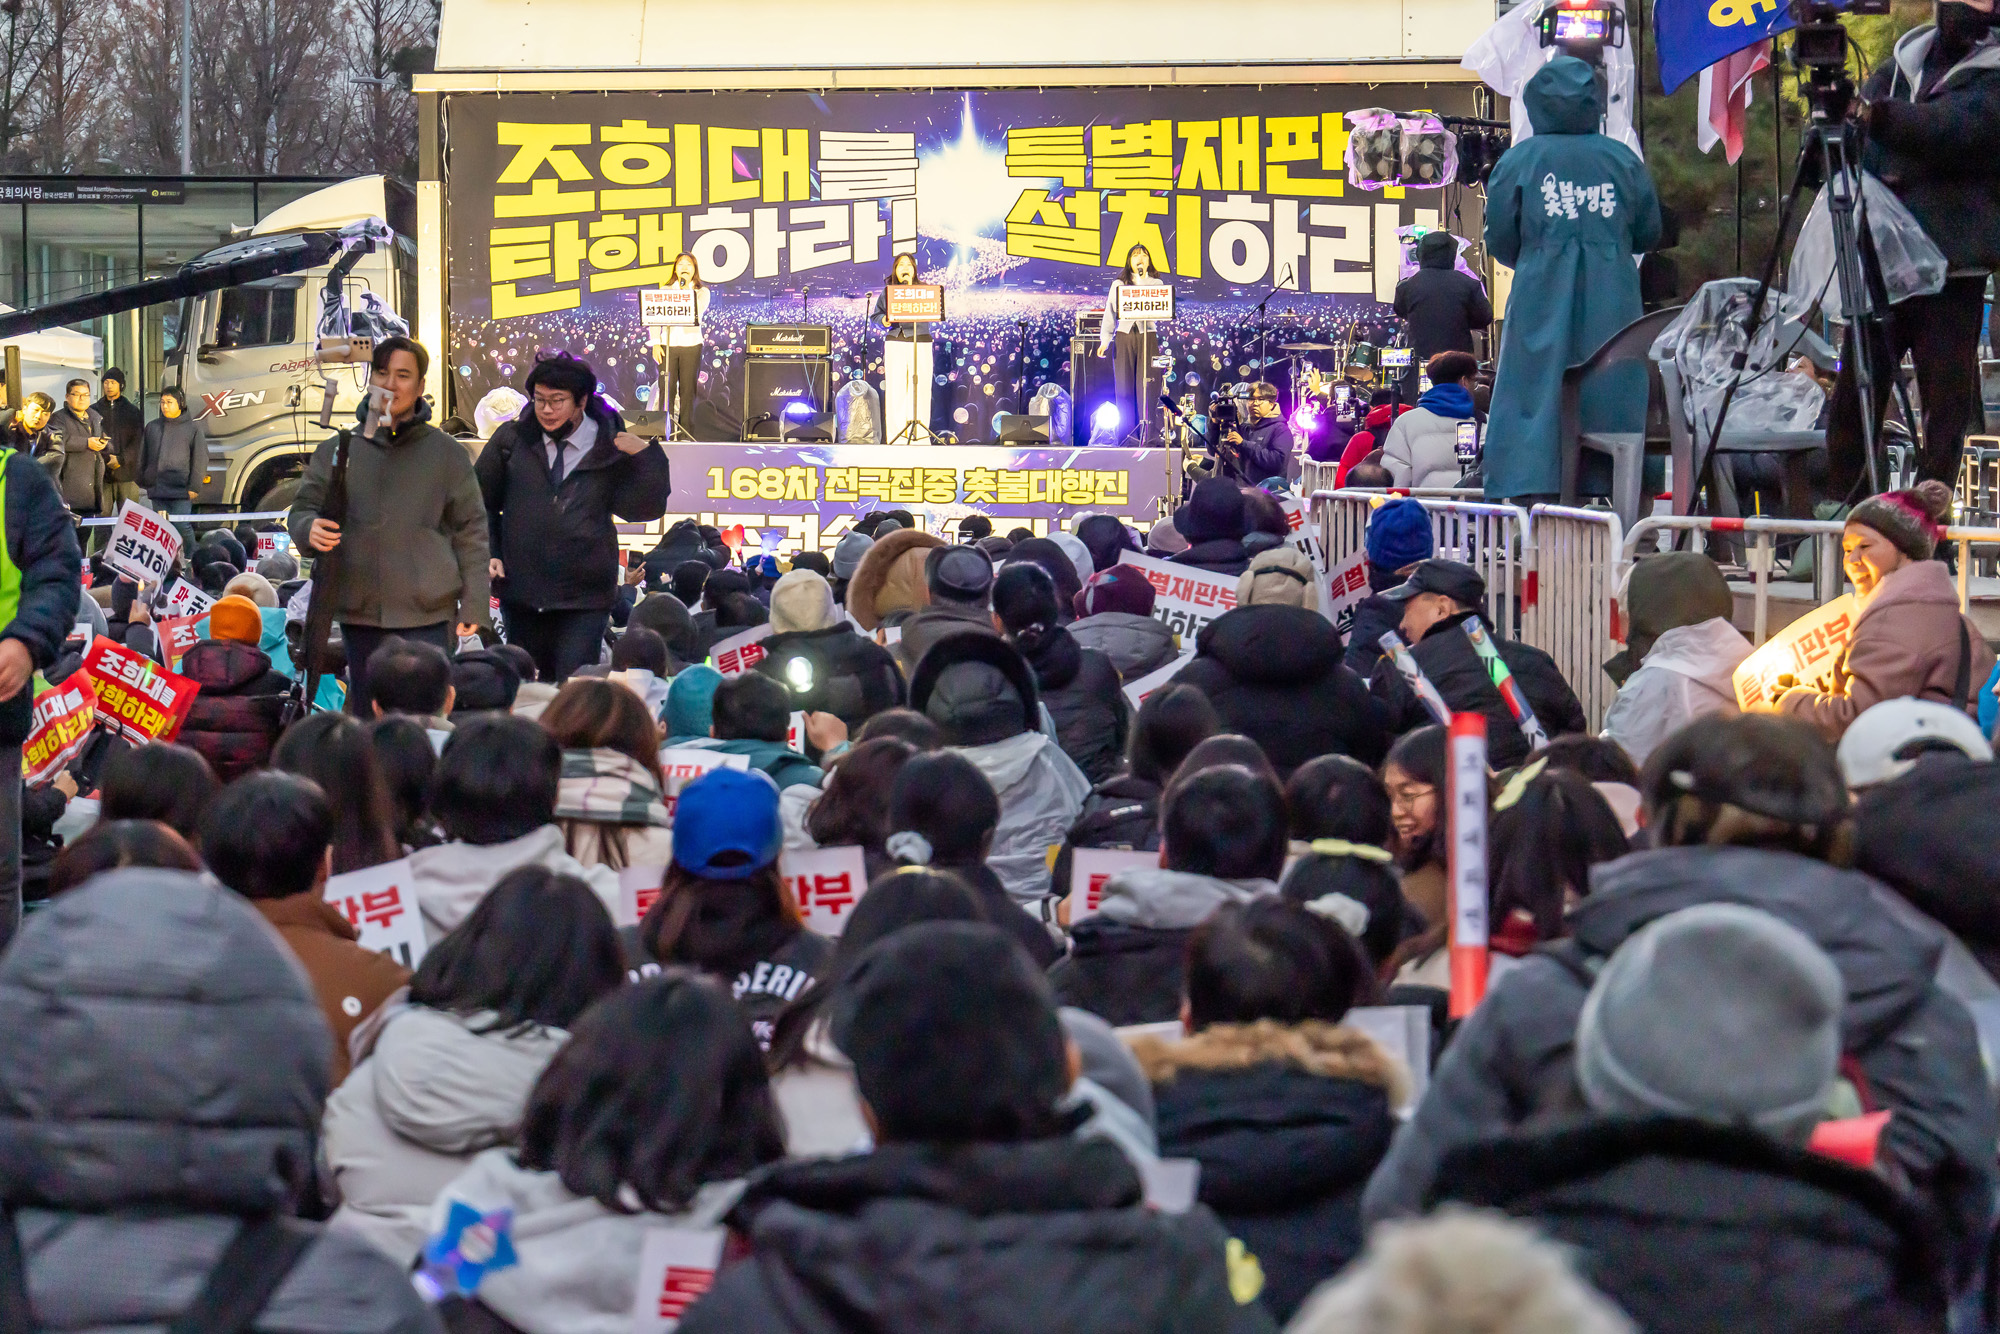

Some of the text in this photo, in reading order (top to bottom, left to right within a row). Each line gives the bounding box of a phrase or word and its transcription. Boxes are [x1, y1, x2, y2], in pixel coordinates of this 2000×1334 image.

[493, 119, 919, 218] 조희대를
[1005, 110, 1433, 199] 특별재판
[1540, 172, 1617, 220] 촛불행동
[489, 199, 918, 320] 탄핵하라!
[1005, 188, 1439, 304] 설치하라
[644, 293, 691, 303] 특별재판부
[645, 305, 691, 317] 설치하라!
[1122, 288, 1169, 298] 특별재판부
[1122, 301, 1169, 312] 설치하라!
[771, 332, 805, 342] Marshall
[769, 386, 803, 397] Marshall
[706, 465, 1129, 506] 168차 전국집중 촛불대행진
[96, 648, 177, 709] 조희대를
